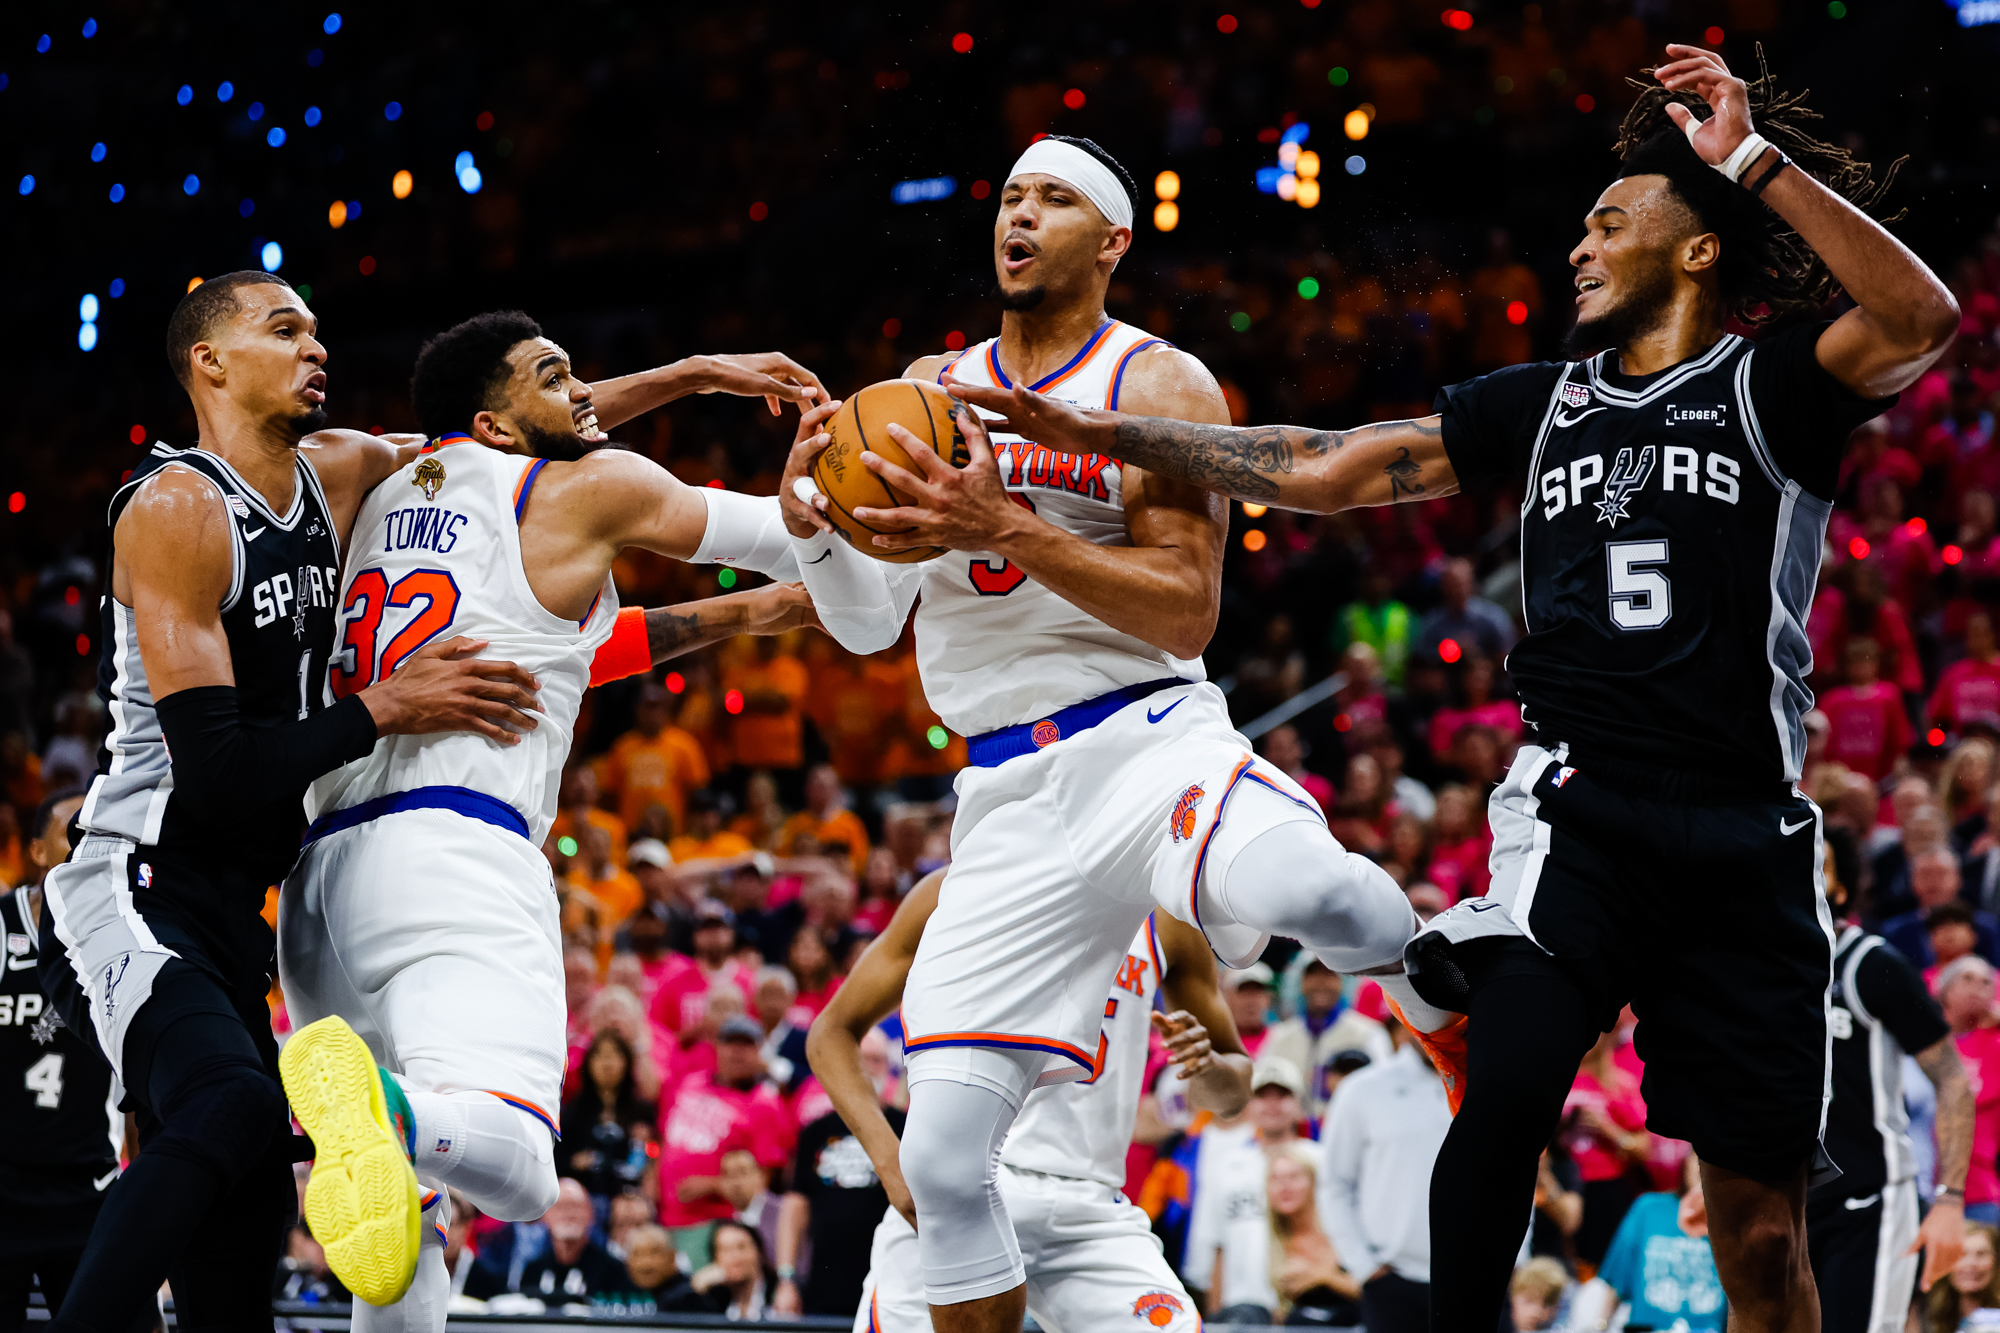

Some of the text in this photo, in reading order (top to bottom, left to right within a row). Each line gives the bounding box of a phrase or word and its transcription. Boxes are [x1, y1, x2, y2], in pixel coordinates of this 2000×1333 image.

[1565, 384, 1589, 394] USA
[1673, 409, 1718, 421] LEDGER
[412, 465, 445, 484] Finals
[1006, 442, 1111, 504] YORK
[1540, 445, 1741, 529] SPURS
[383, 507, 469, 554] TOWNS
[1605, 538, 1673, 631] 5
[328, 566, 462, 700] 32
[297, 648, 312, 721] 1
[24, 1052, 66, 1111] 4
